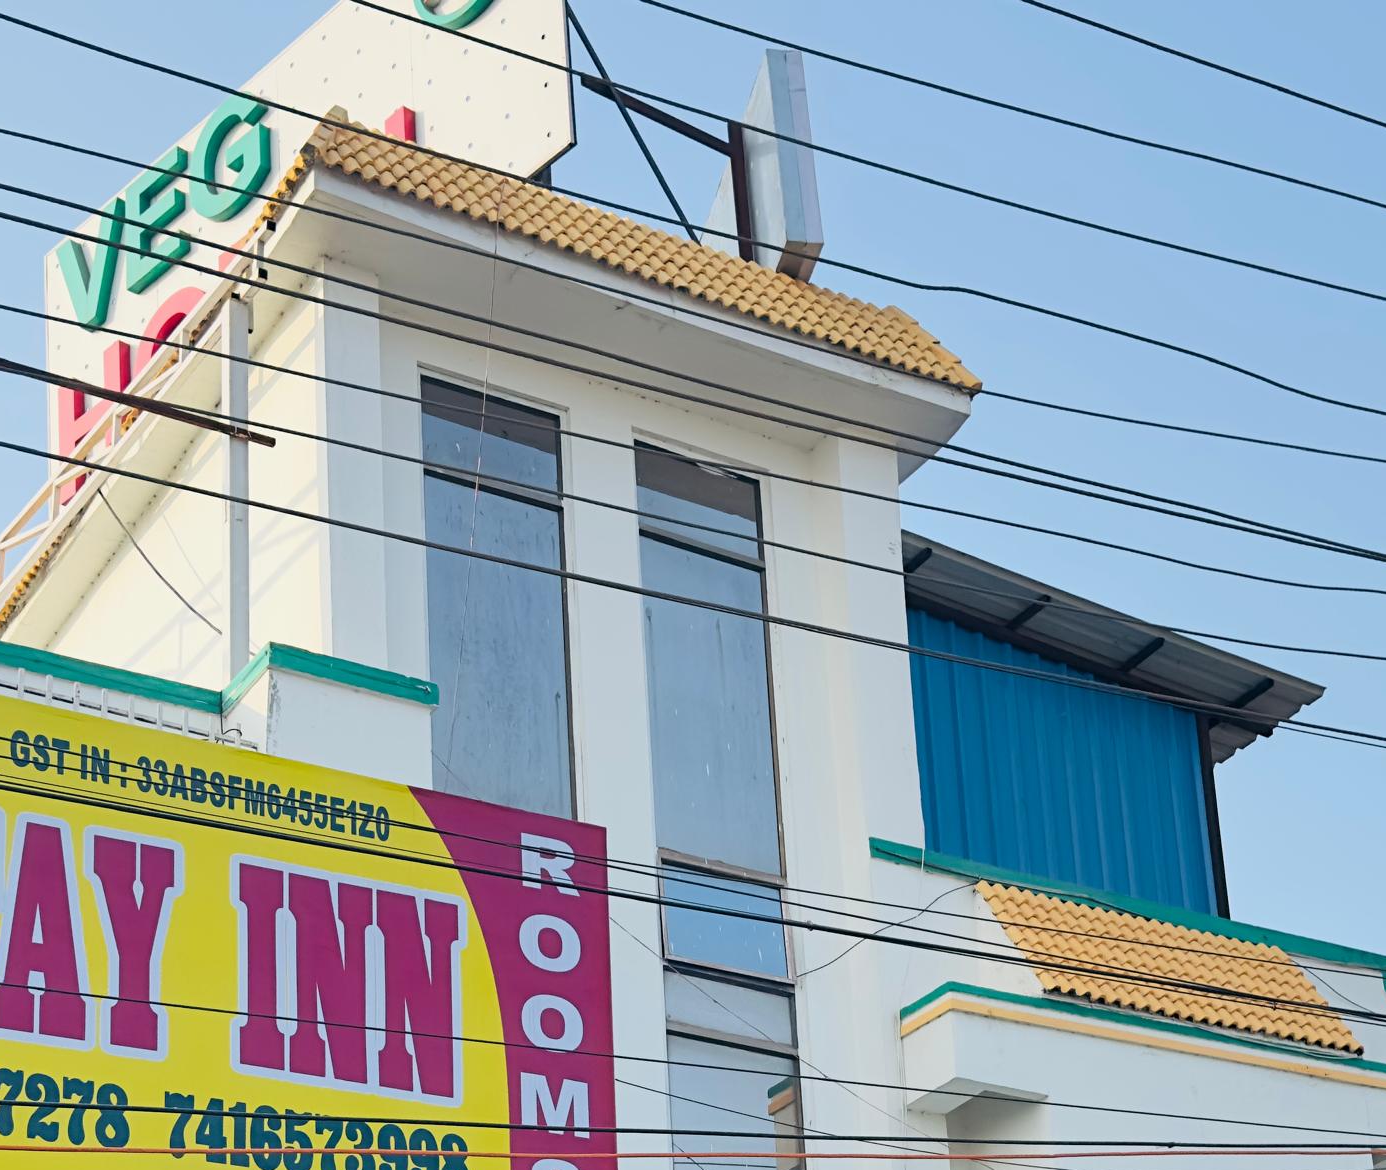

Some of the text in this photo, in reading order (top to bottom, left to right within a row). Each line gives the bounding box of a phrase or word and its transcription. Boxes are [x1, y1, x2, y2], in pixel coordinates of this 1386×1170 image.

[56, 92, 272, 333] VEG
[10, 729, 70, 775] GST
[239, 863, 461, 1099] INN
